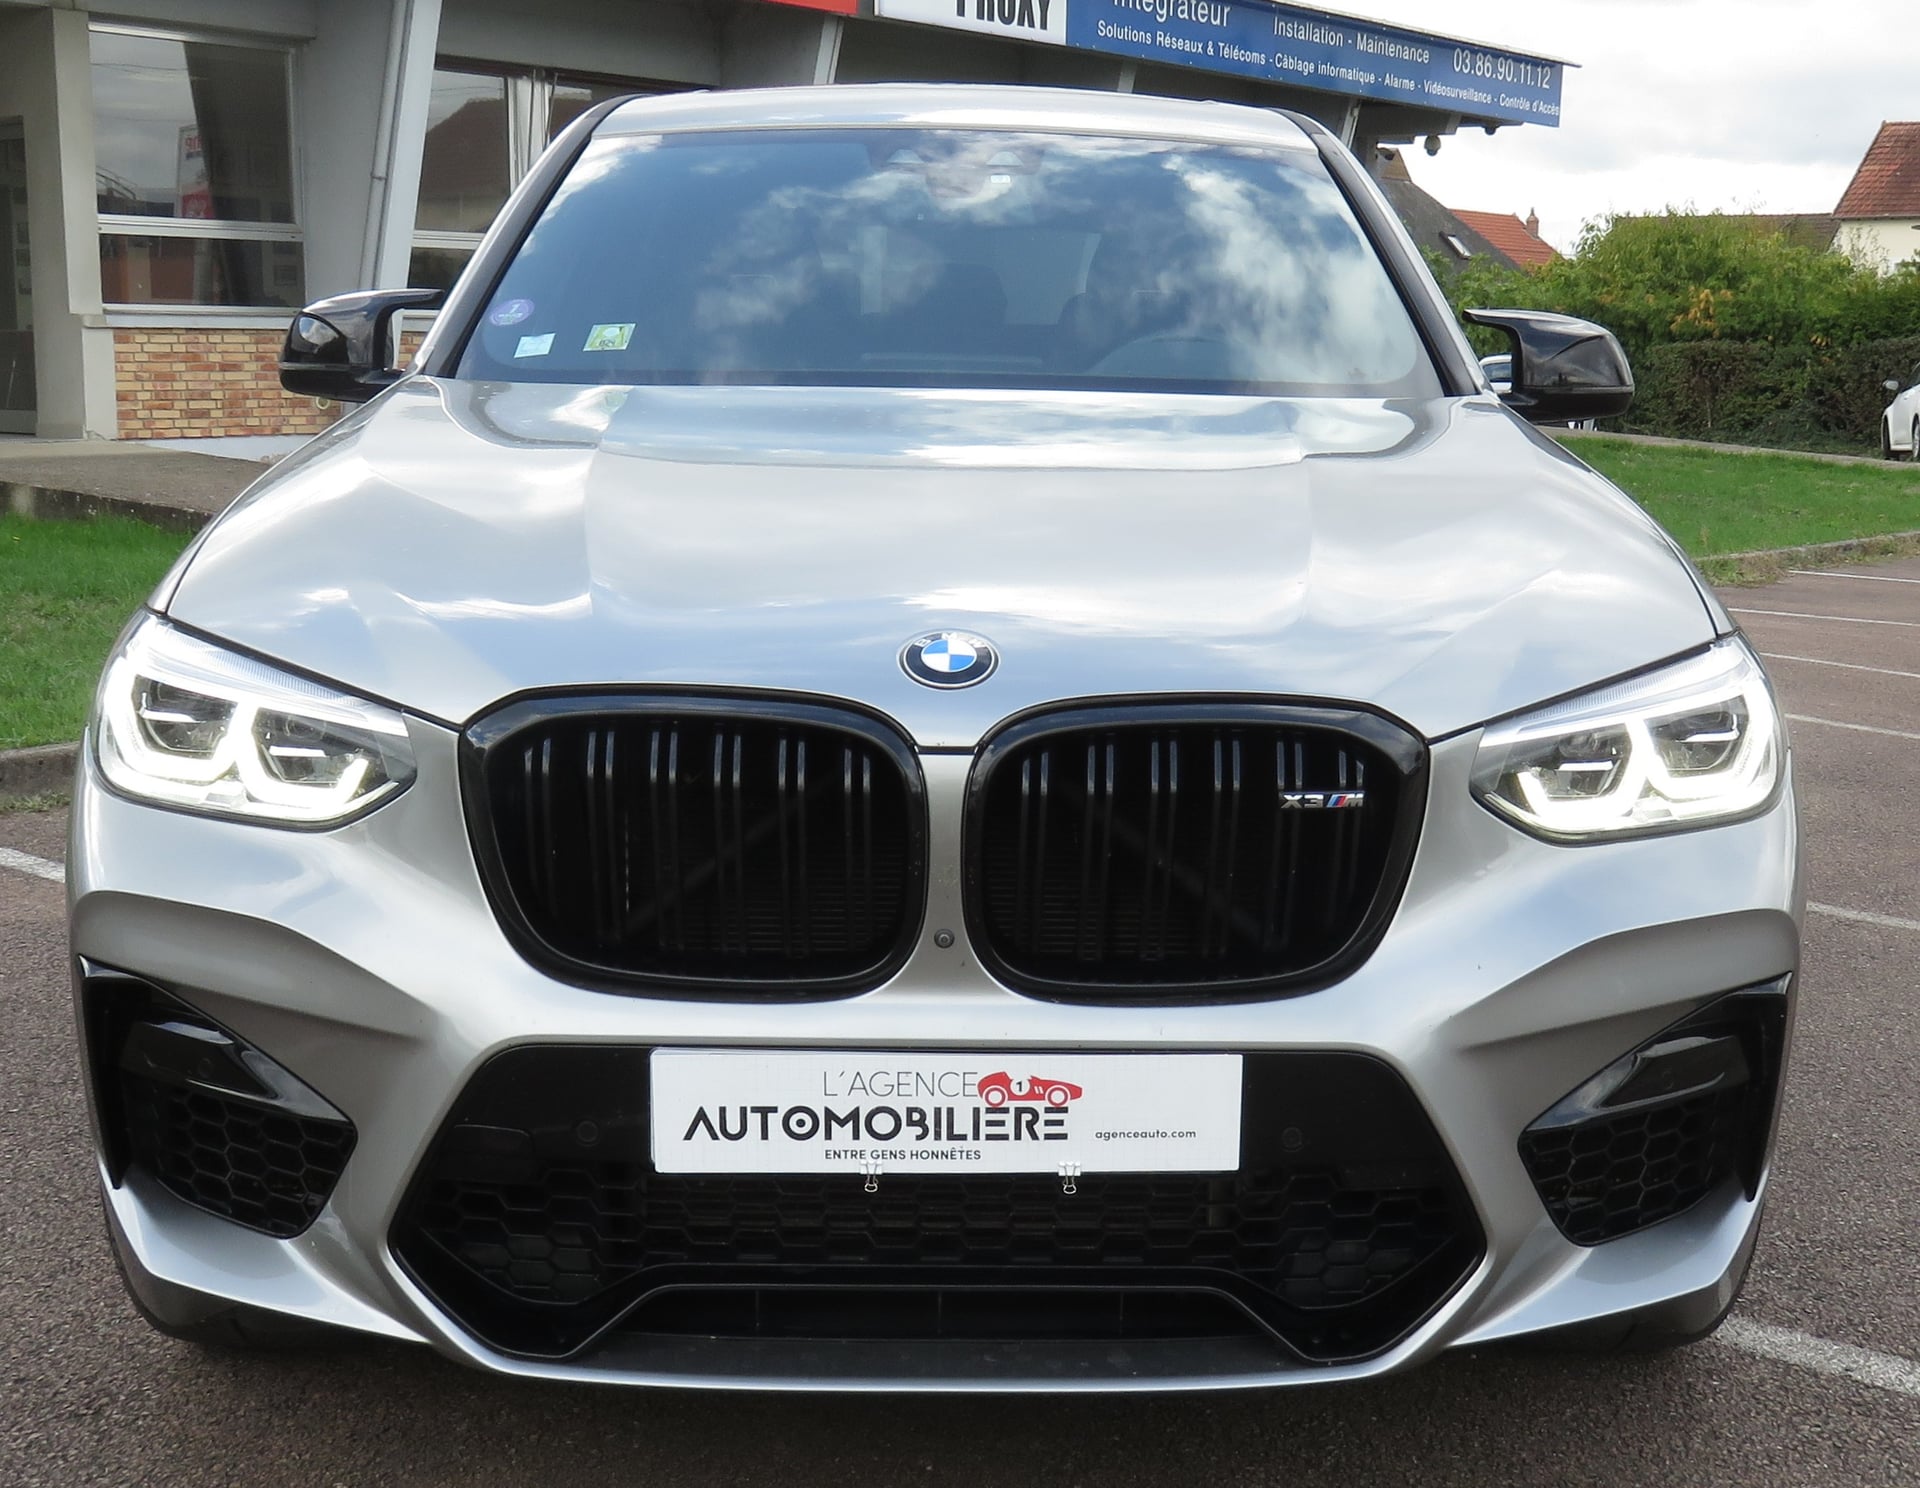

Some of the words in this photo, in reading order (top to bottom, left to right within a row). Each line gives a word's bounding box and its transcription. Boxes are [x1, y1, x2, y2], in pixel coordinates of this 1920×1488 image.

[1114, 0, 1231, 27] grateur
[1273, 16, 1343, 47] Installation
[1356, 32, 1430, 64] Maintenance
[1097, 20, 1152, 44] Solutions
[1156, 31, 1203, 54] Réseaux
[1207, 41, 1214, 56] &
[1218, 42, 1265, 65] Télécoms
[1275, 53, 1314, 76] Câblage
[1318, 61, 1375, 84] informatique
[1384, 73, 1415, 91] Alarme
[1424, 79, 1492, 104] Vidéosurveillance
[1499, 94, 1530, 111] Contrôle
[1532, 101, 1560, 116] d'Accès
[1453, 48, 1551, 89] 03.86.90.11.12
[1281, 793, 1324, 808] X3
[1016, 1080, 1023, 1092] 1
[1095, 1128, 1197, 1141] agenceauto.com
[825, 1149, 867, 1160] ENTRE
[870, 1149, 906, 1160] GENS
[910, 1147, 981, 1160] HONNÊTES
